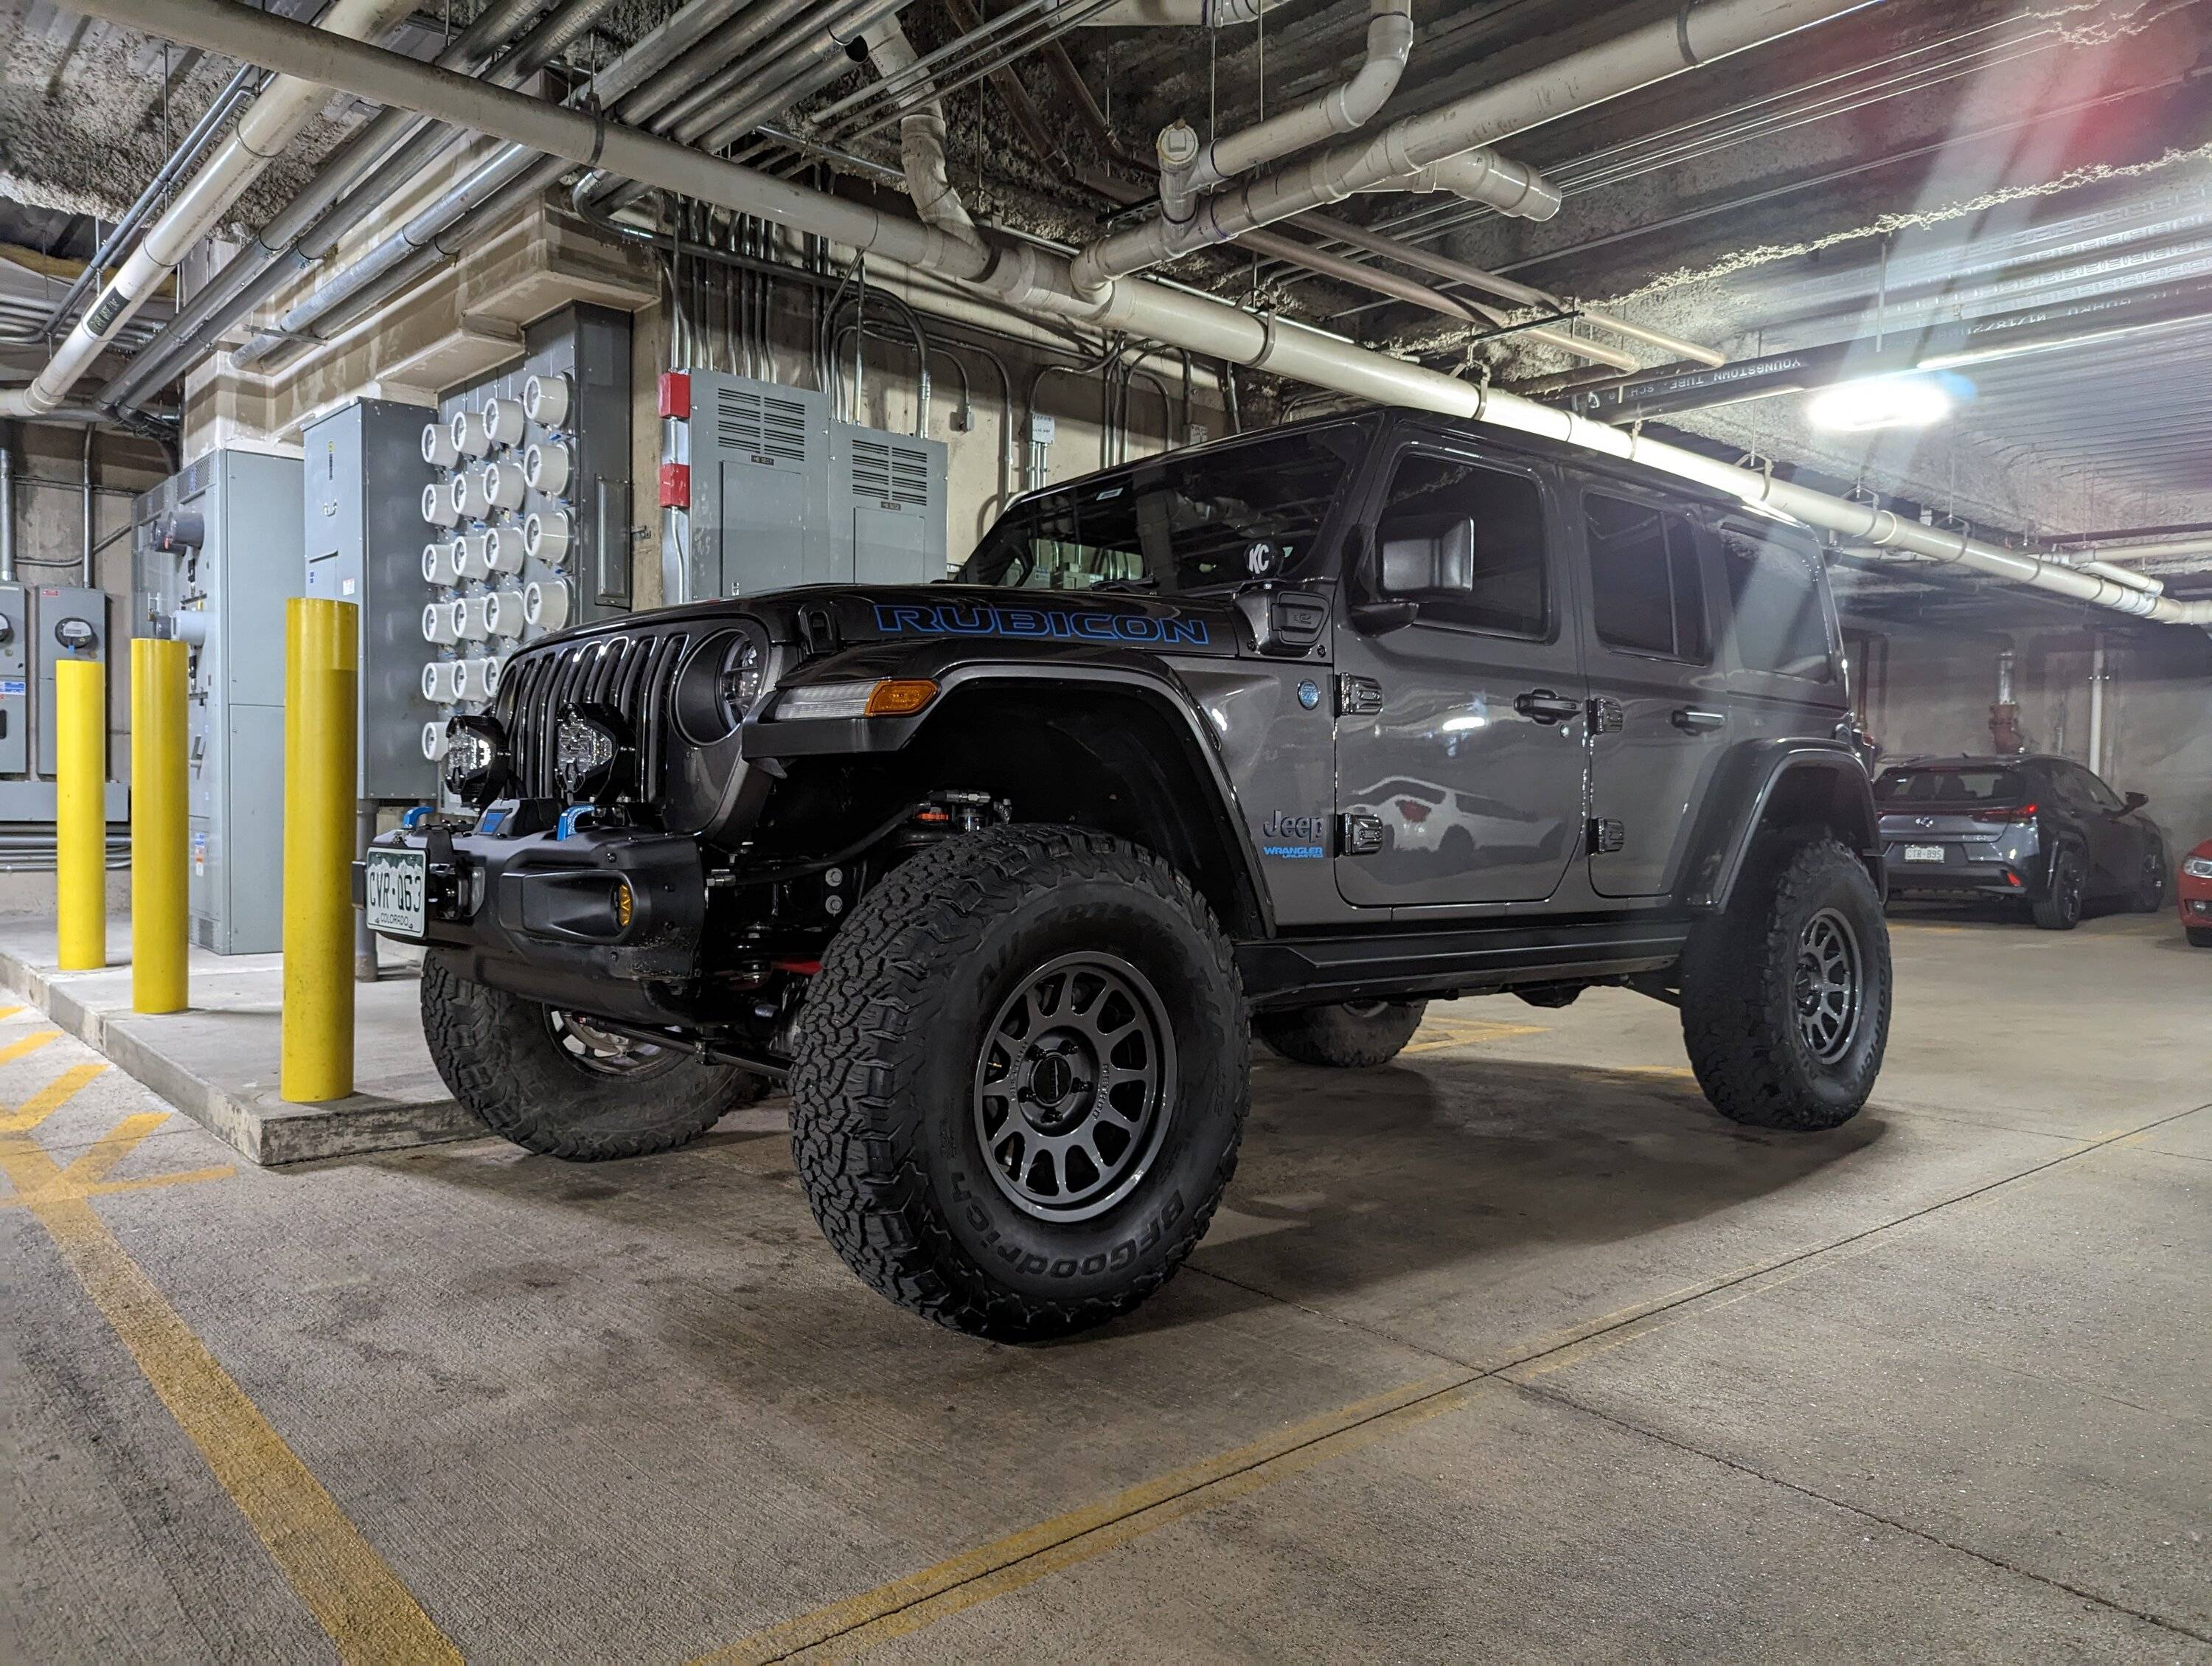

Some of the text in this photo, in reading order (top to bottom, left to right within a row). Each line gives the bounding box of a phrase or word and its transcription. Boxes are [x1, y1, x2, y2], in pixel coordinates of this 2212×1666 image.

[1713, 357, 1802, 382] YOUNGSTOWN
[1248, 543, 1270, 575] KC
[872, 603, 1210, 646] RUBICON
[1262, 808, 1324, 844] Jeep
[1262, 846, 1324, 855] WRANGLER
[369, 871, 422, 913] CVR-Q63
[380, 912, 409, 927] COLORADO
[950, 1171, 1185, 1278] BFGoodrich
